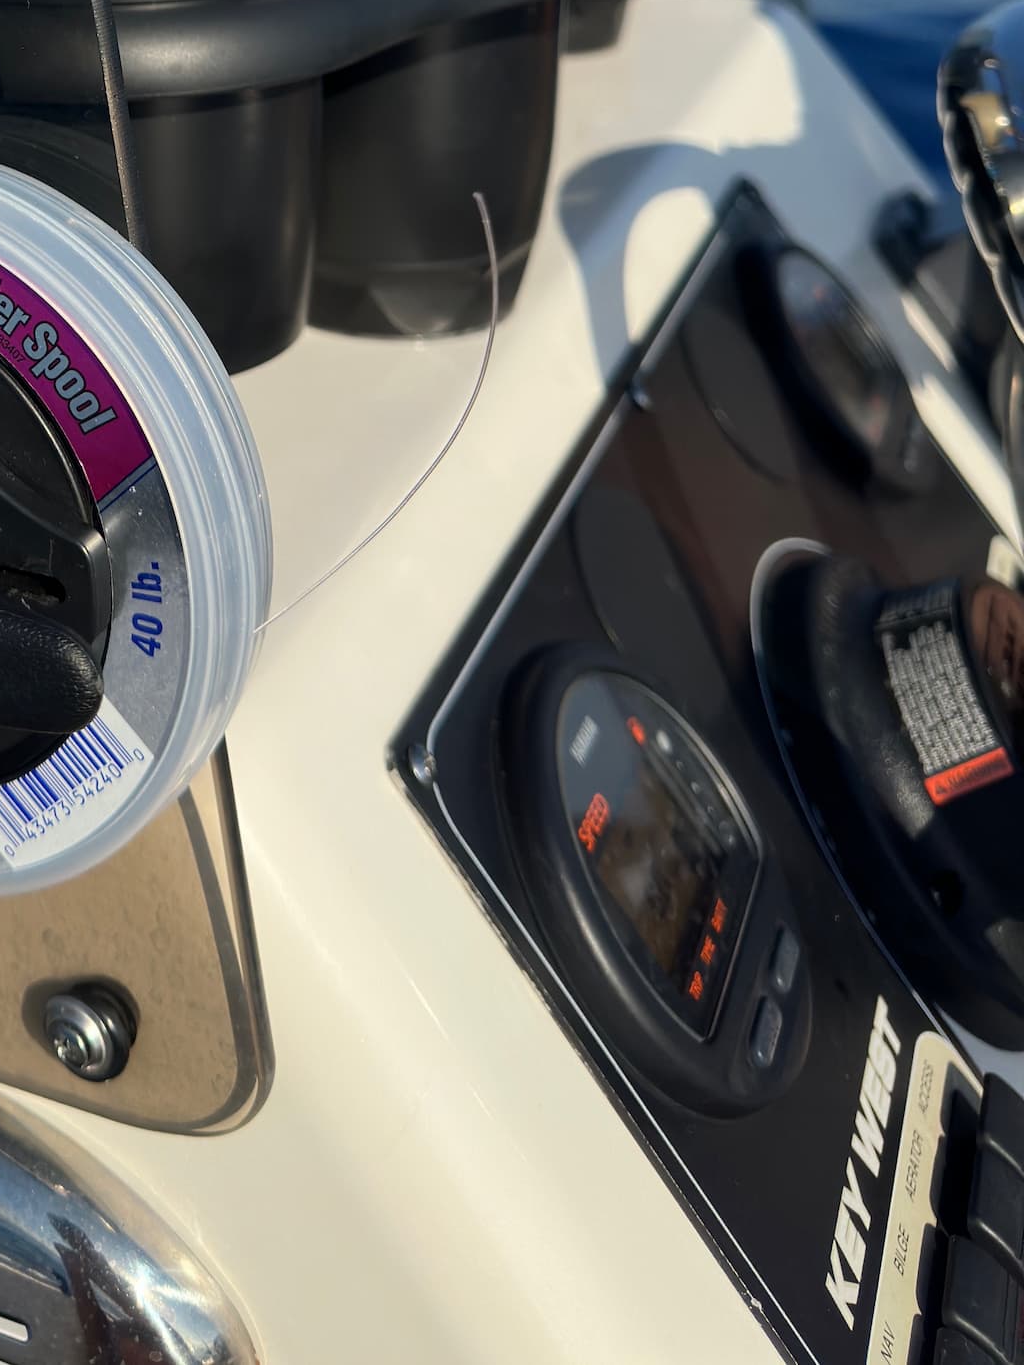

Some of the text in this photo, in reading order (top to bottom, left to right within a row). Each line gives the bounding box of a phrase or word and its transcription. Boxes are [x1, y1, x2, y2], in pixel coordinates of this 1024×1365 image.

[22, 321, 118, 434] Spool
[131, 561, 164, 657] 40 lb.
[25, 800, 71, 839] 43473
[72, 763, 123, 805] 54240
[578, 793, 610, 853] SPEED
[825, 994, 902, 1331] KEY WEST
[905, 1129, 924, 1204] AERATOR
[893, 1223, 911, 1277] BILGE
[880, 1321, 896, 1365] NAV
